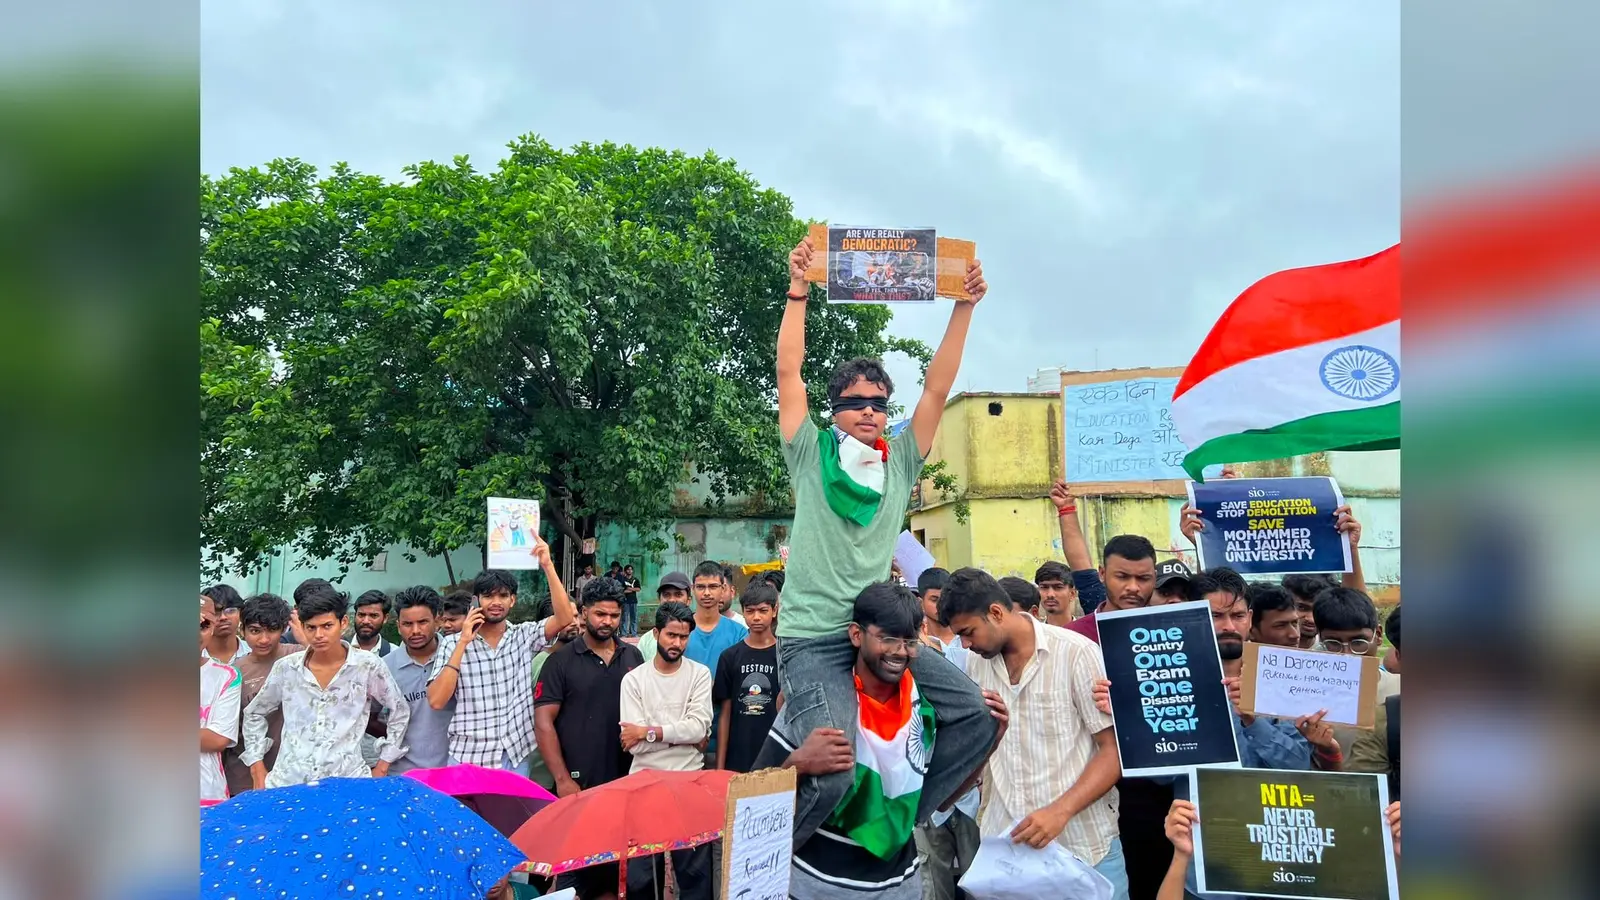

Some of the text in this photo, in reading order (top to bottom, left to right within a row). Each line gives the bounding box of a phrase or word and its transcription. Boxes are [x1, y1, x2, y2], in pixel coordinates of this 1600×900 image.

[846, 229, 905, 239] ARE WE REALLY
[842, 238, 917, 251] DEMOCRATIC?
[1078, 380, 1158, 404] एक दिन
[1114, 432, 1141, 449] Dega
[1077, 454, 1155, 475] MINISTER
[1248, 487, 1265, 497] sio
[1220, 498, 1311, 510] SAVE EDUCATION
[1216, 506, 1317, 518] STOP DEMOLITION
[1248, 518, 1285, 530] SAVE
[1224, 528, 1311, 541] MOHAMMED
[1226, 538, 1312, 552] ALI JAUHAR
[1225, 549, 1315, 562] UNIVERSITY
[1129, 627, 1183, 644] One
[1132, 640, 1184, 654] Country
[1134, 652, 1188, 669] One
[1262, 654, 1278, 666] Na
[1332, 660, 1348, 672] Na
[741, 664, 774, 674] DESTROY
[1136, 667, 1191, 682] Exam
[1139, 680, 1193, 697] One
[1141, 694, 1195, 706] Disaster
[1142, 704, 1196, 718] Every
[1145, 717, 1199, 733] Year
[1155, 737, 1178, 753] sio
[1260, 784, 1315, 807] NTA=
[1263, 807, 1316, 828] NEVER
[1246, 823, 1336, 847] TRUSTABLE
[1261, 844, 1324, 864] AGENCY
[1272, 867, 1296, 883] sio
